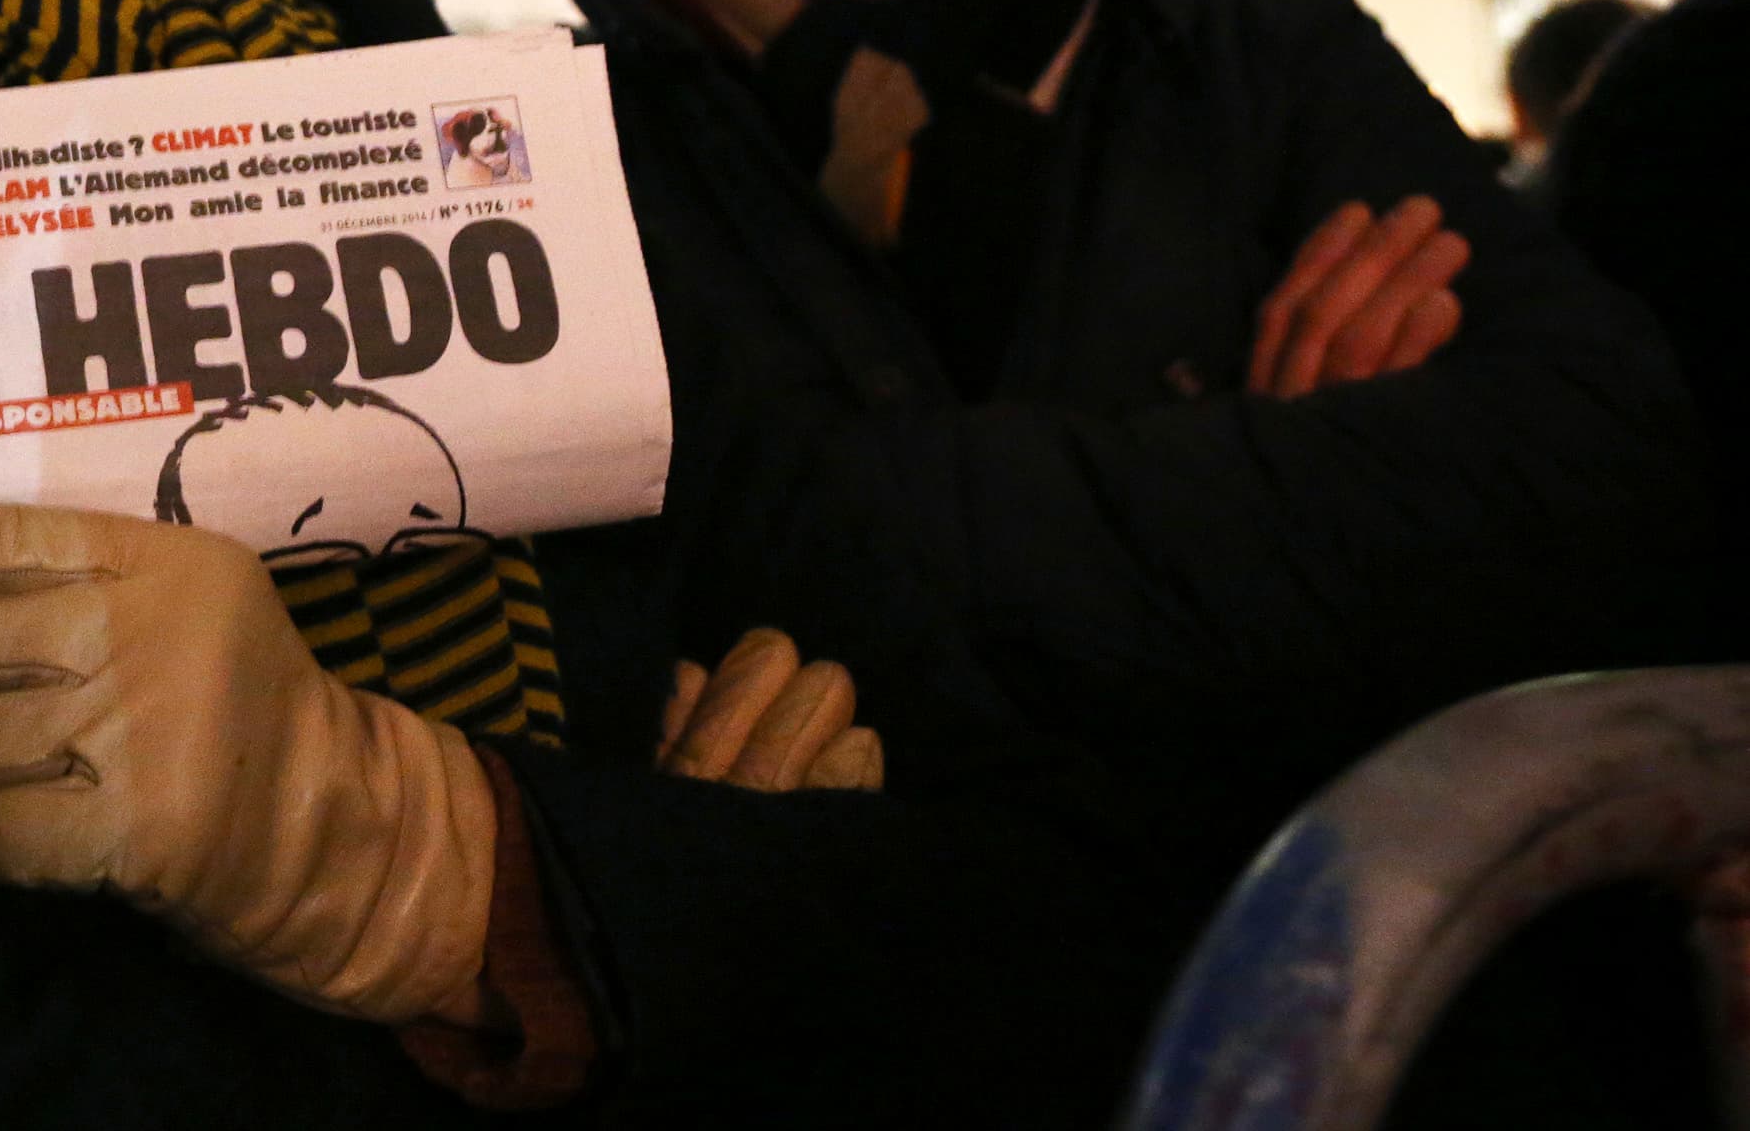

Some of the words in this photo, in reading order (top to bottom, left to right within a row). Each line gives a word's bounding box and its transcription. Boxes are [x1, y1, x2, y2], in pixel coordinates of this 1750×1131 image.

[152, 122, 254, 154] CLIMAT
[261, 121, 295, 143] Le
[300, 107, 418, 139] touriste
[59, 159, 230, 197] L'Allemand
[238, 138, 423, 178] décomplexé
[108, 201, 174, 227] Mon
[189, 190, 263, 218] amie
[276, 186, 306, 208] la
[319, 175, 429, 205] finance
[465, 199, 504, 216] 1176
[31, 218, 561, 400] HEBDO
